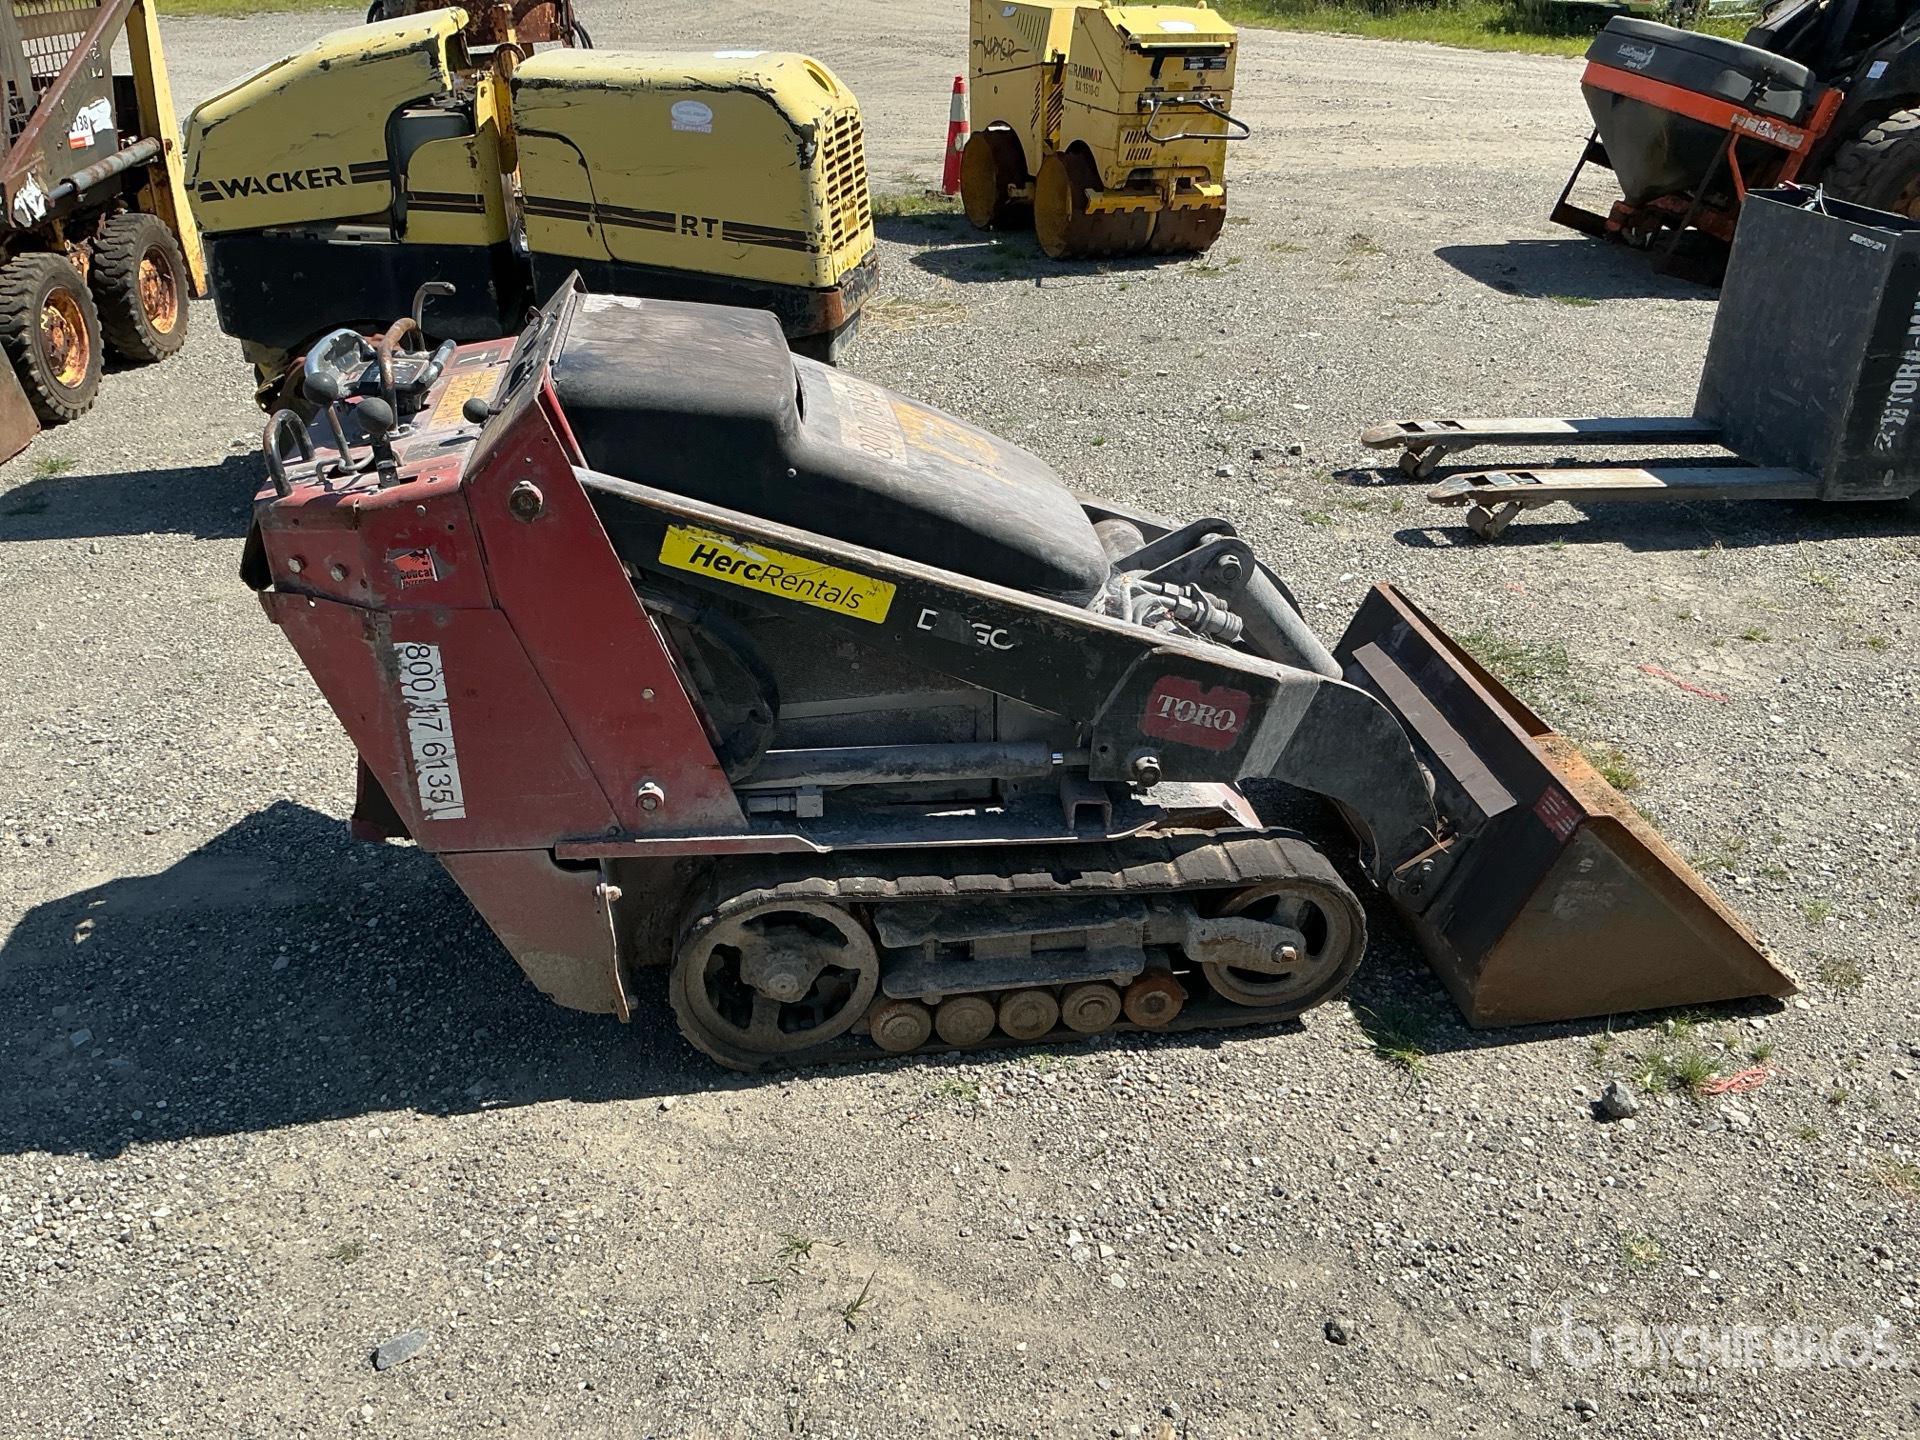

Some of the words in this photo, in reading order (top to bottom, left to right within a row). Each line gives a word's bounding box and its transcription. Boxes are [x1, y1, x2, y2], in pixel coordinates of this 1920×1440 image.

[1073, 63, 1103, 84] RAMMAX
[1075, 80, 1083, 92] RX
[218, 166, 347, 198] WACKER
[681, 214, 719, 239] RT
[859, 425, 893, 459] 800
[689, 544, 864, 610] HercRentals
[405, 645, 437, 692] 800
[416, 707, 444, 733] 17
[1156, 694, 1237, 731] TORO
[422, 742, 454, 804] 6135
